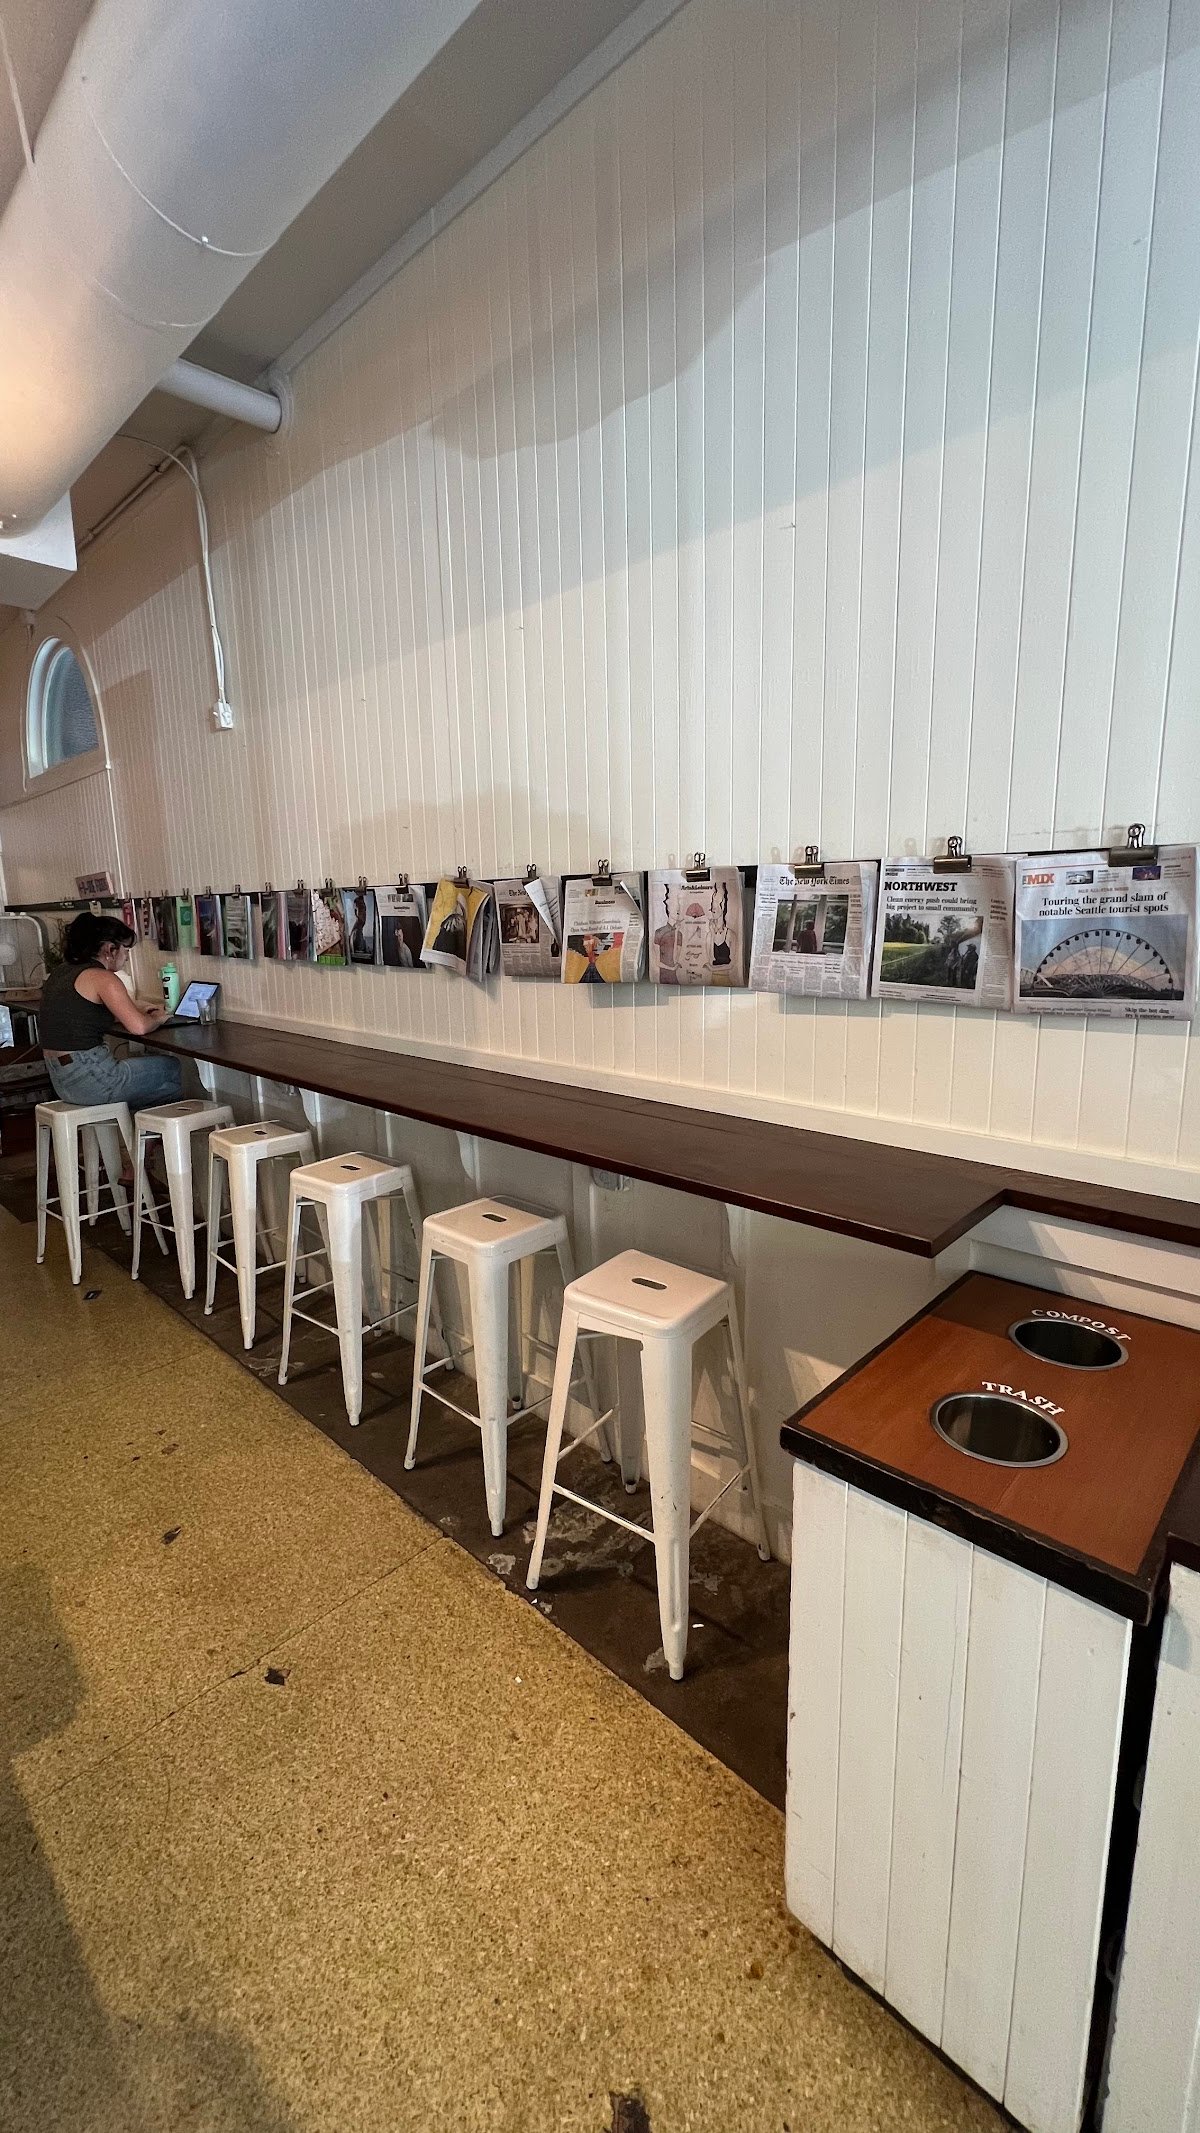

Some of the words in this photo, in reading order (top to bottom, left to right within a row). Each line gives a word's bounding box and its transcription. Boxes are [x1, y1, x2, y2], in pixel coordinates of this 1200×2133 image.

[780, 876, 794, 886] The
[810, 877, 828, 887] York
[829, 876, 850, 885] Times
[884, 881, 958, 891] NORTHWEST
[904, 897, 924, 905] energy
[925, 897, 940, 905] push
[960, 897, 977, 905] bring
[1042, 896, 1079, 907] Touring
[1082, 895, 1097, 905] the
[1100, 893, 1128, 904] grand
[1130, 892, 1154, 902] slam
[1157, 891, 1168, 901] of
[1039, 907, 1073, 917] notable
[1075, 905, 1107, 915] Seattle
[1109, 904, 1140, 913] tourist
[1143, 903, 1169, 914] spots
[1031, 1309, 1132, 1342] COMPOST
[981, 1381, 1065, 1416] TRASH
